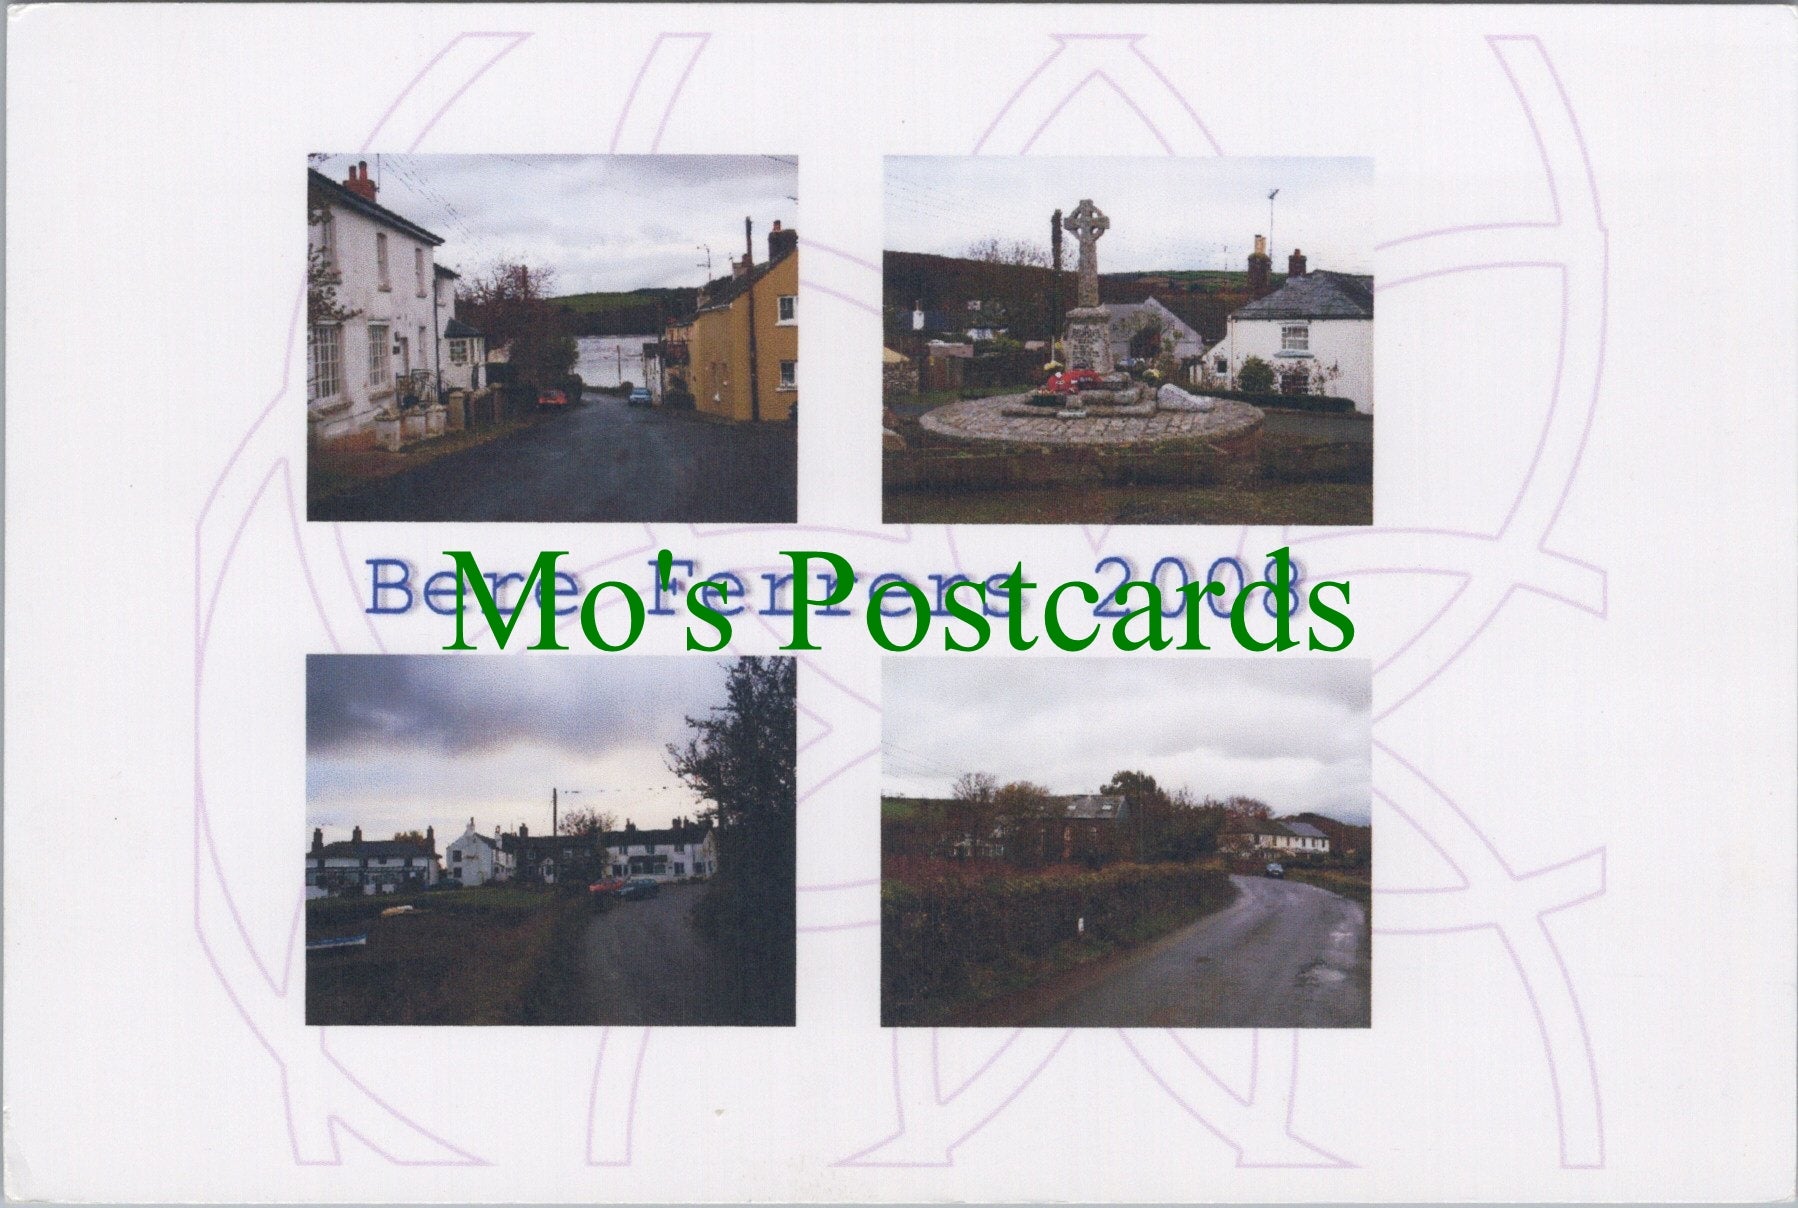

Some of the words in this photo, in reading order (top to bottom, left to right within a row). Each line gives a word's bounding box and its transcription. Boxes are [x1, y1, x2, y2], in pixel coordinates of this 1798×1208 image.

[366, 557, 579, 616] Bere
[646, 559, 1020, 618] Ferrers
[1092, 555, 1302, 619] 2008
